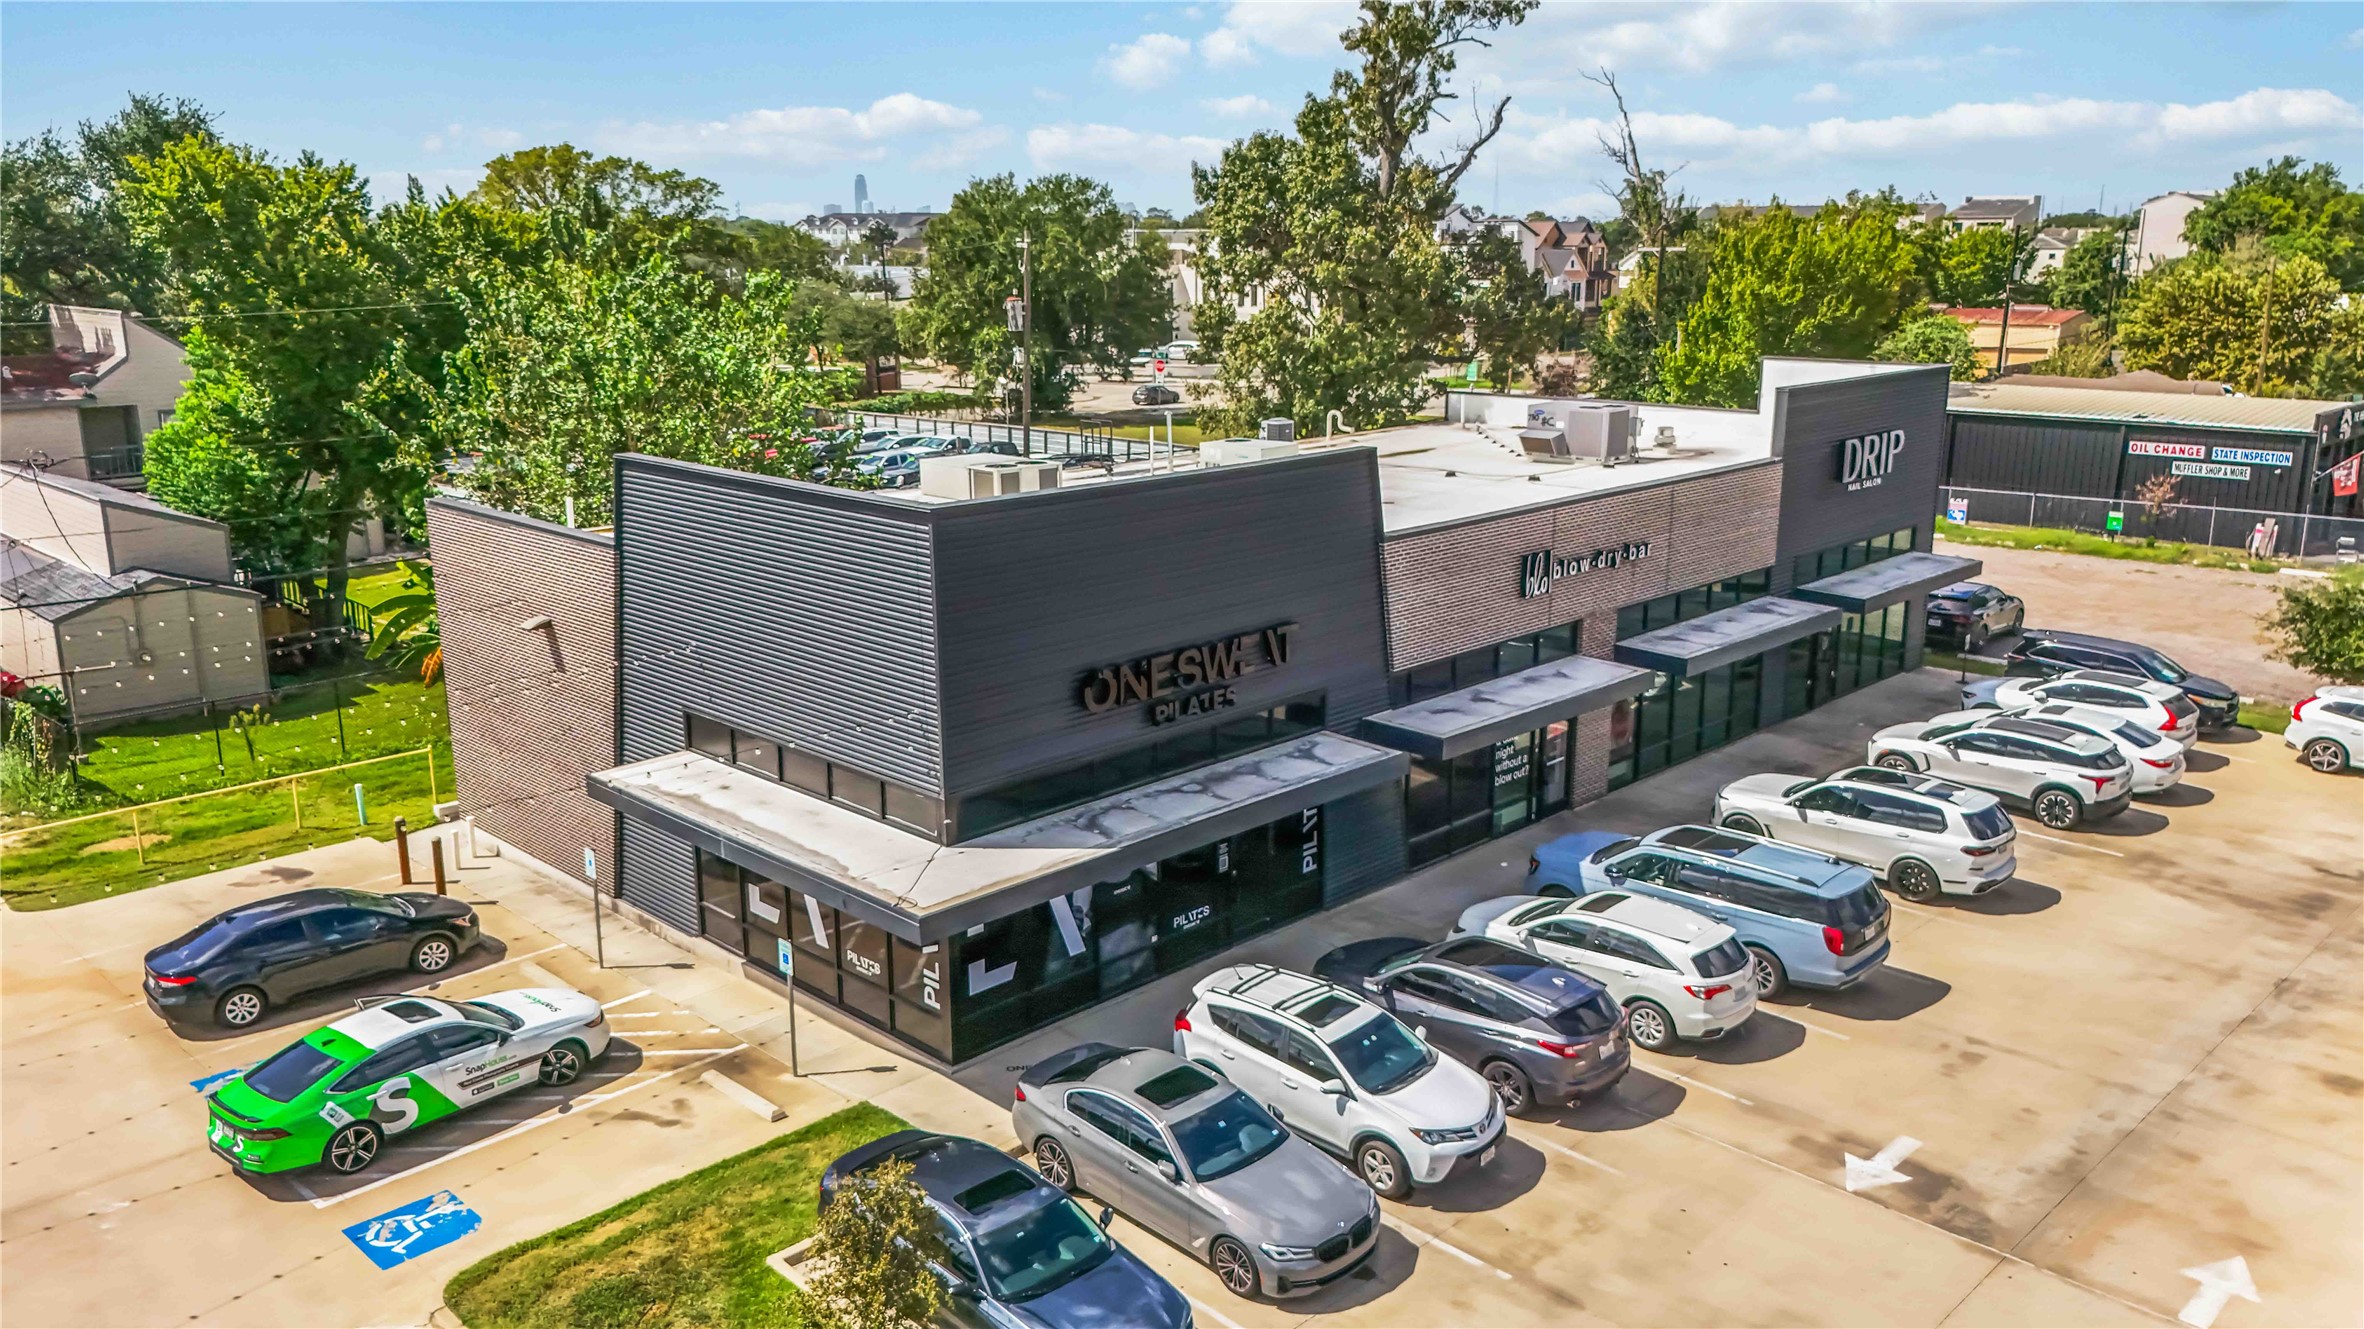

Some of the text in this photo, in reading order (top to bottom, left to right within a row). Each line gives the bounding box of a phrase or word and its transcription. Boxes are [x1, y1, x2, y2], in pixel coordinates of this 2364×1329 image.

[1842, 429, 1905, 483] DRIP
[2130, 443, 2202, 457] OIL CHANGE
[2214, 448, 2291, 464] STATE INSPECTION
[2174, 463, 2249, 478] MUFFLER SHOP & MORE
[1847, 477, 1882, 492] NAIL SALON
[1524, 551, 1549, 600] blo
[1154, 686, 1238, 725] PILATES
[1495, 745, 1514, 759] night
[1494, 754, 1528, 773] without a
[1494, 764, 1530, 786] blow out?
[1302, 808, 1318, 874] PILAT
[1173, 905, 1210, 928] PILATES
[376, 1076, 419, 1135] S
